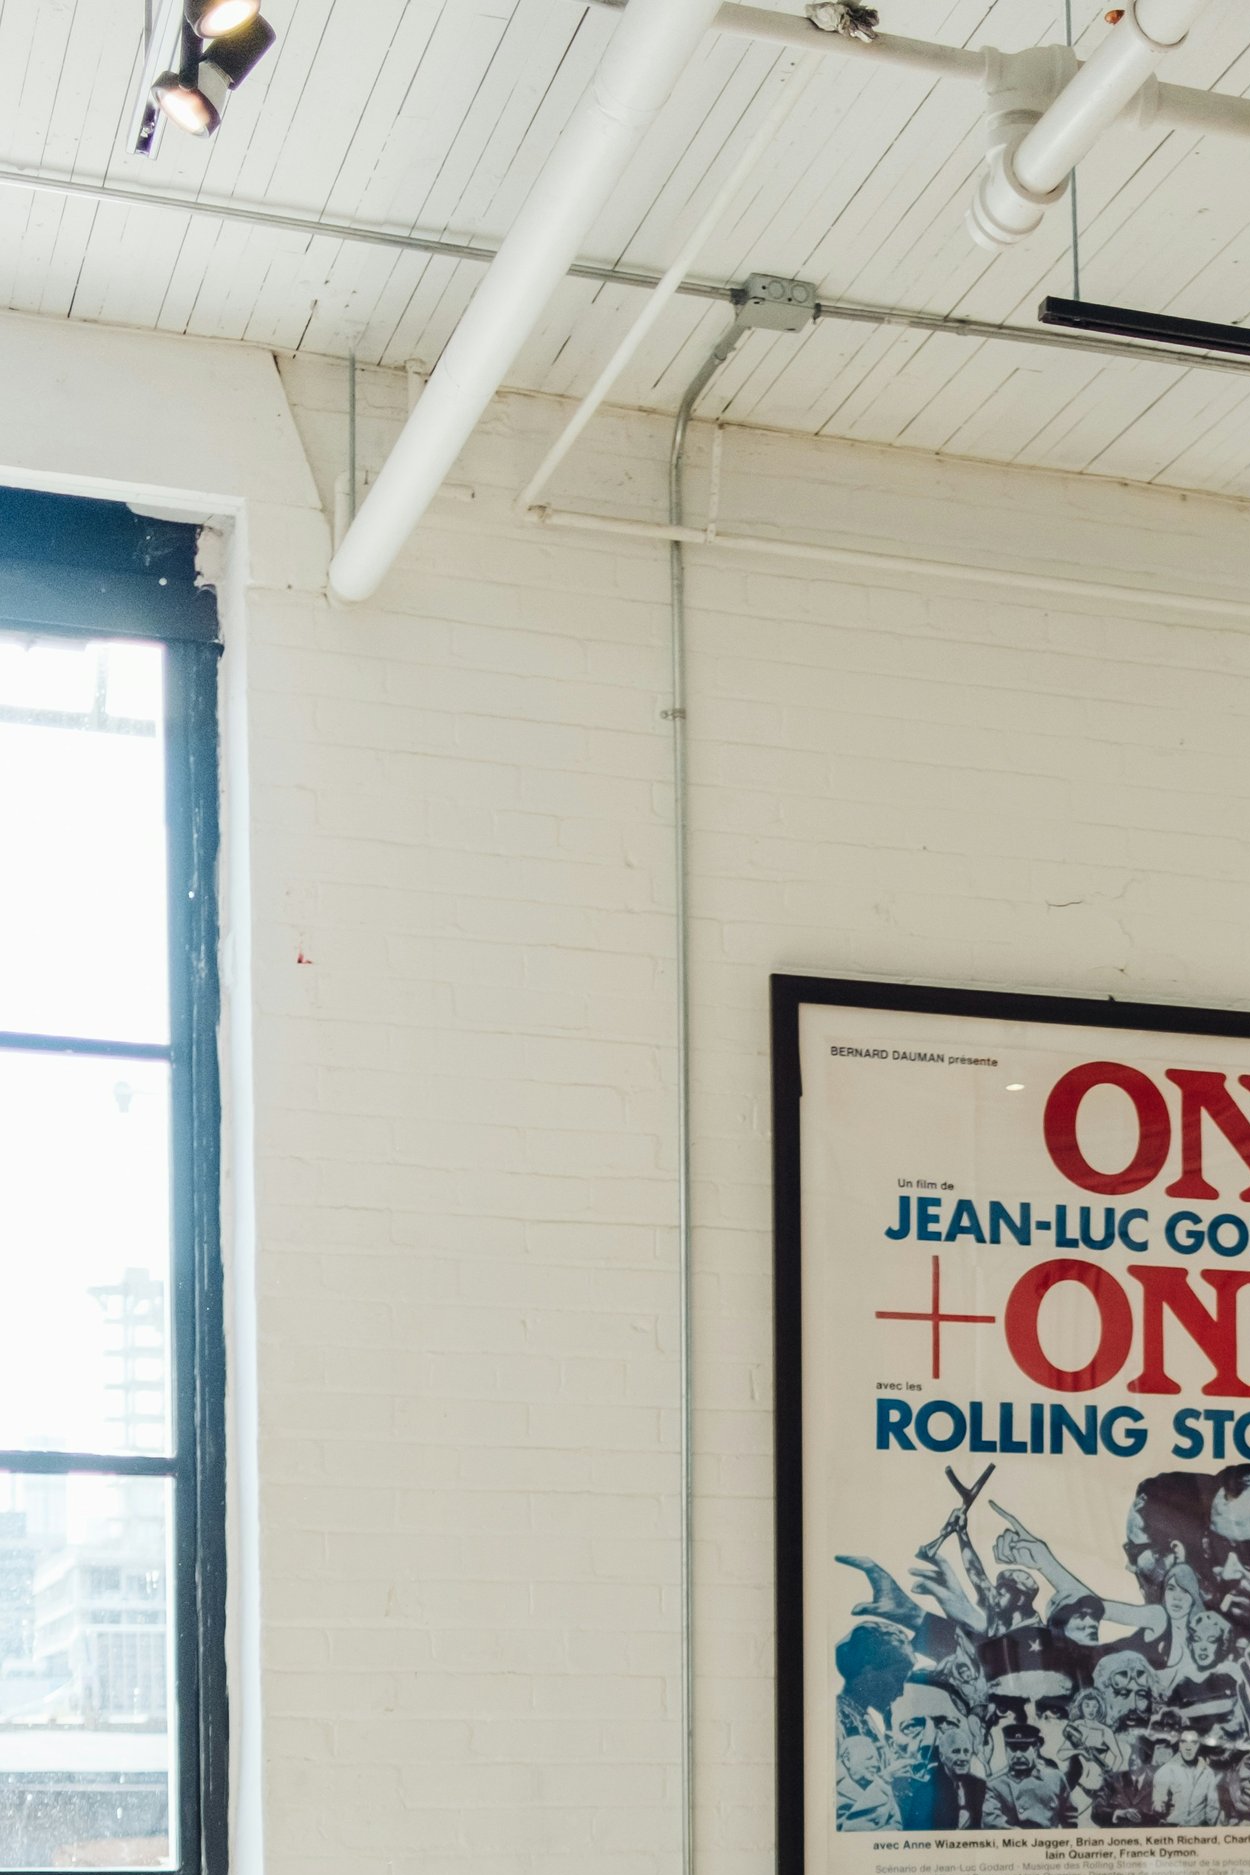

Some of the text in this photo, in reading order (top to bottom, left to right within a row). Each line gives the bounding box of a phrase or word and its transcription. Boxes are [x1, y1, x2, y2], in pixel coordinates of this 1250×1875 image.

[830, 1046, 999, 1068] BERNARD DAUMAN présente
[898, 1178, 954, 1192] Un film de
[885, 1195, 1149, 1253] JEAN-LUC
[875, 1381, 923, 1391] avec les
[875, 1398, 1148, 1458] ROLLING
[873, 1842, 900, 1851] avec
[903, 1840, 932, 1850] Anne
[934, 1838, 999, 1850] Wiazemski,
[1002, 1838, 1028, 1849] Mick
[1031, 1837, 1073, 1850] Jagger,
[1076, 1837, 1105, 1847] Brian
[1107, 1836, 1143, 1848] Jones,
[1145, 1835, 1174, 1846] Keith
[1177, 1834, 1221, 1845] Richard,
[1045, 1848, 1200, 1860] Iain Quarrier, Franck Dymon.
[875, 1863, 918, 1874] Scénario
[920, 1864, 932, 1873] de
[934, 1863, 977, 1872] Jean-Luc
[980, 1862, 1015, 1872] Godard
[1022, 1861, 1061, 1872] Musique
[1064, 1861, 1080, 1870] des
[1082, 1859, 1114, 1871] Rolling
[1116, 1859, 1147, 1869] Stones
[1155, 1858, 1197, 1868] Directeur
[1199, 1858, 1211, 1867] de
[1212, 1857, 1220, 1866] la
